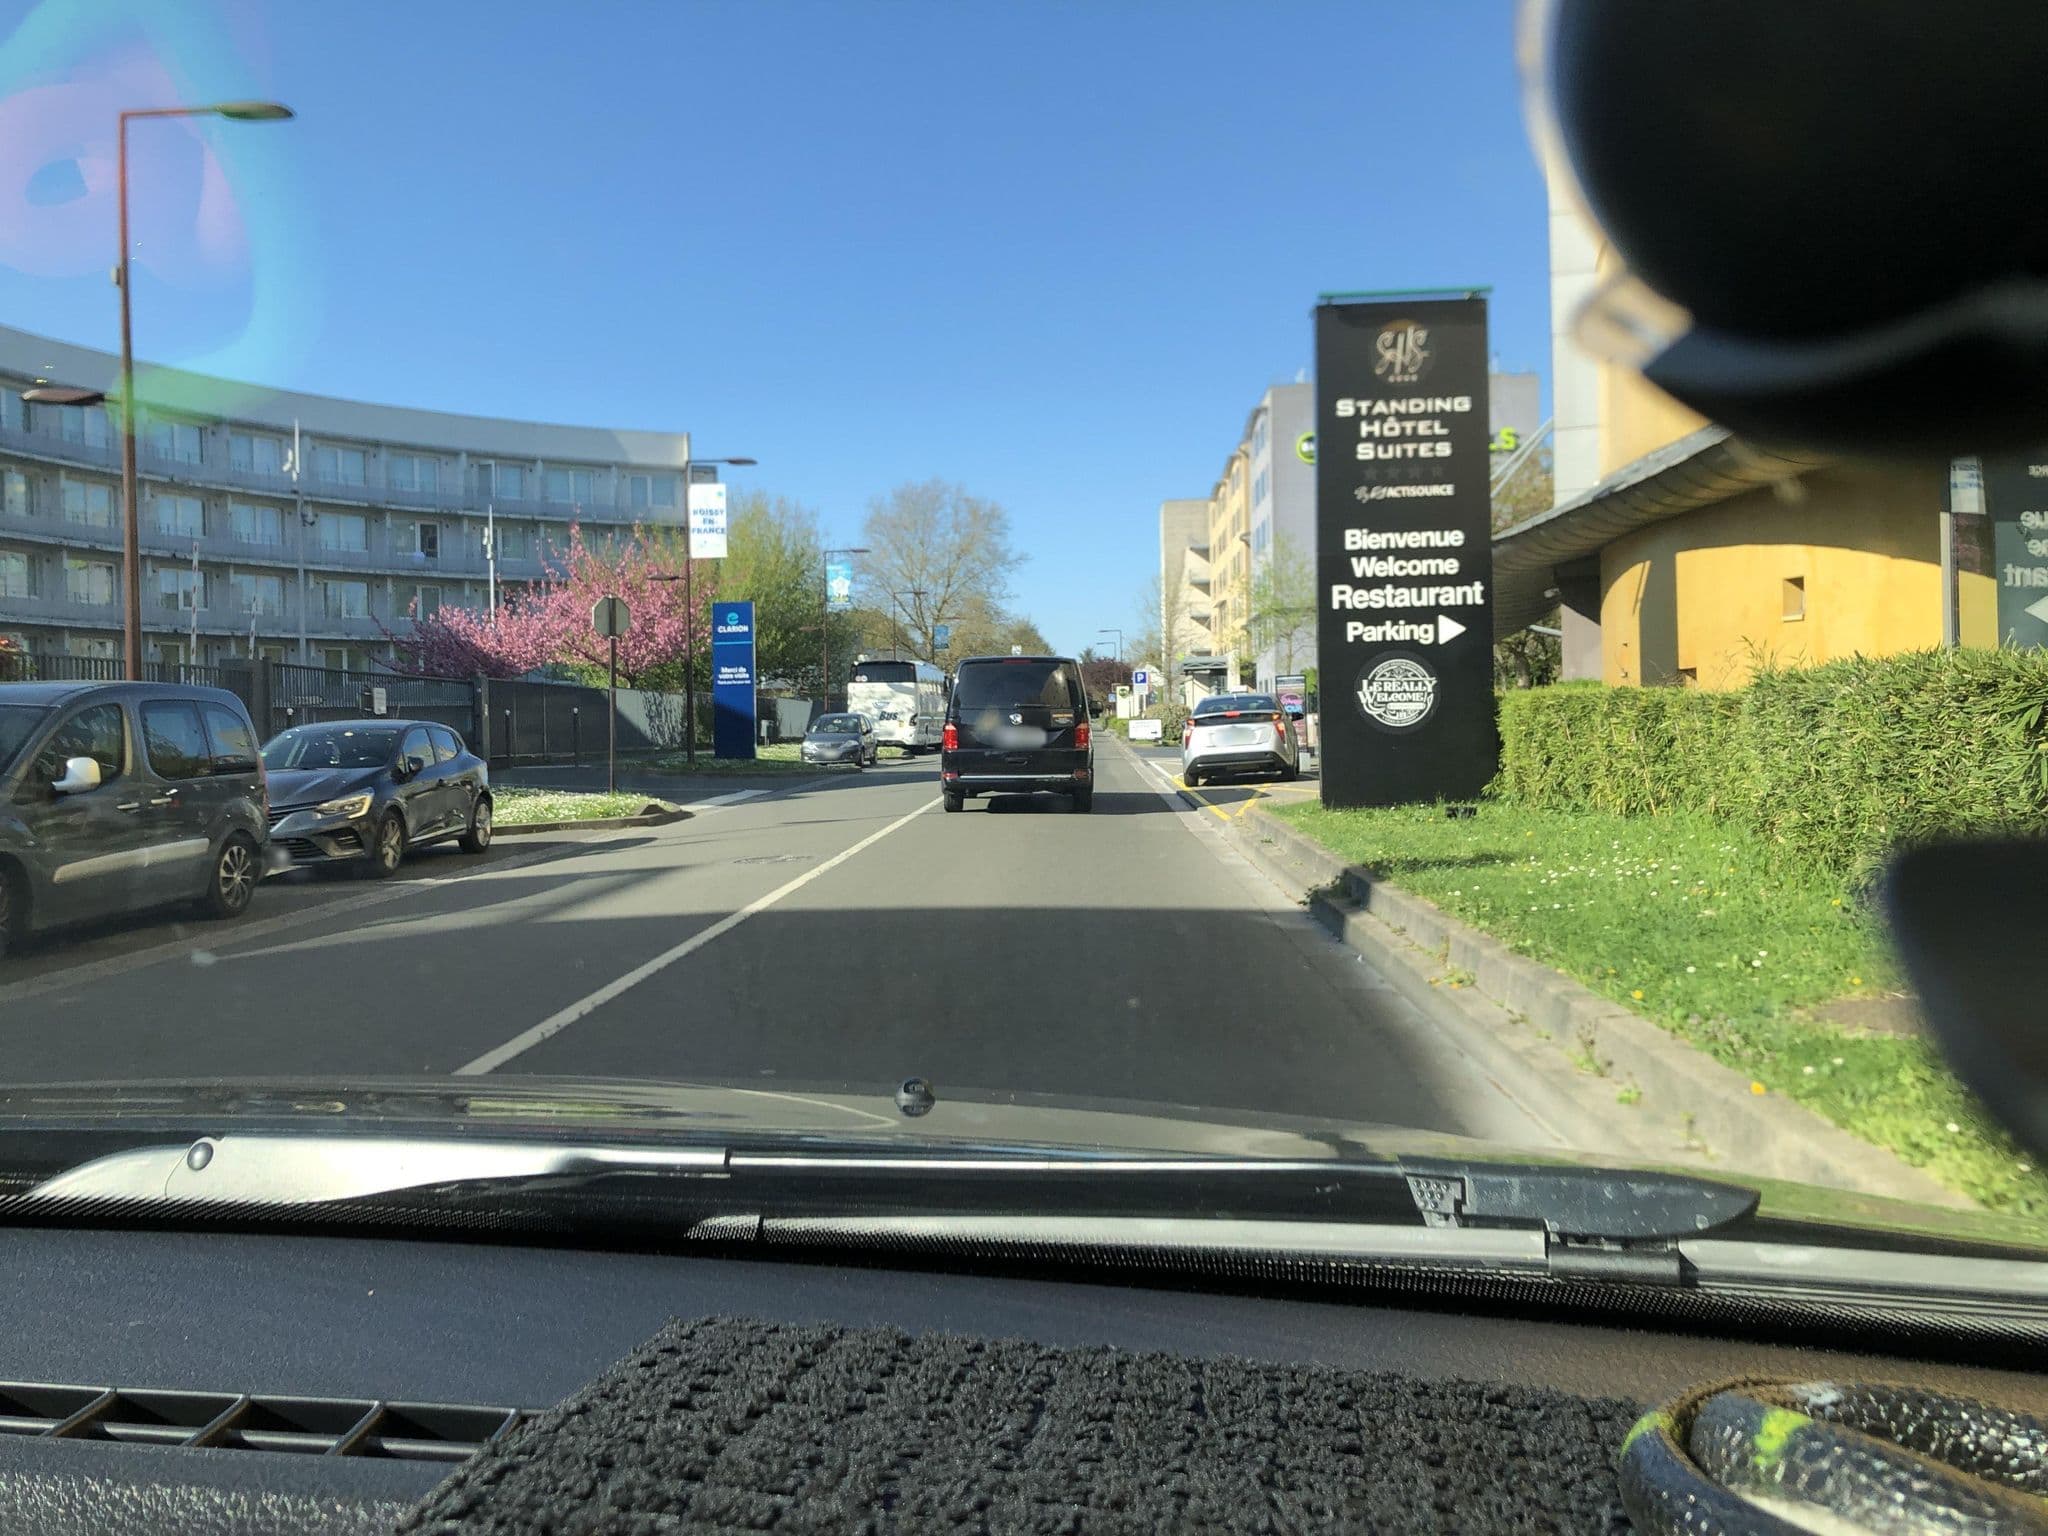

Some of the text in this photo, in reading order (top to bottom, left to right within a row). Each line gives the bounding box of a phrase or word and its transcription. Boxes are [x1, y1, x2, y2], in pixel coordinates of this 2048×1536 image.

[1336, 396, 1472, 417] STANDING
[1360, 416, 1449, 438] HÔTEL
[1356, 442, 1452, 460] SUITES
[1345, 529, 1465, 550] Bienvenue
[1351, 556, 1460, 578] Welcome
[1332, 580, 1484, 609] Restaurant
[717, 625, 749, 633] CLARION
[1347, 620, 1435, 645] Parking
